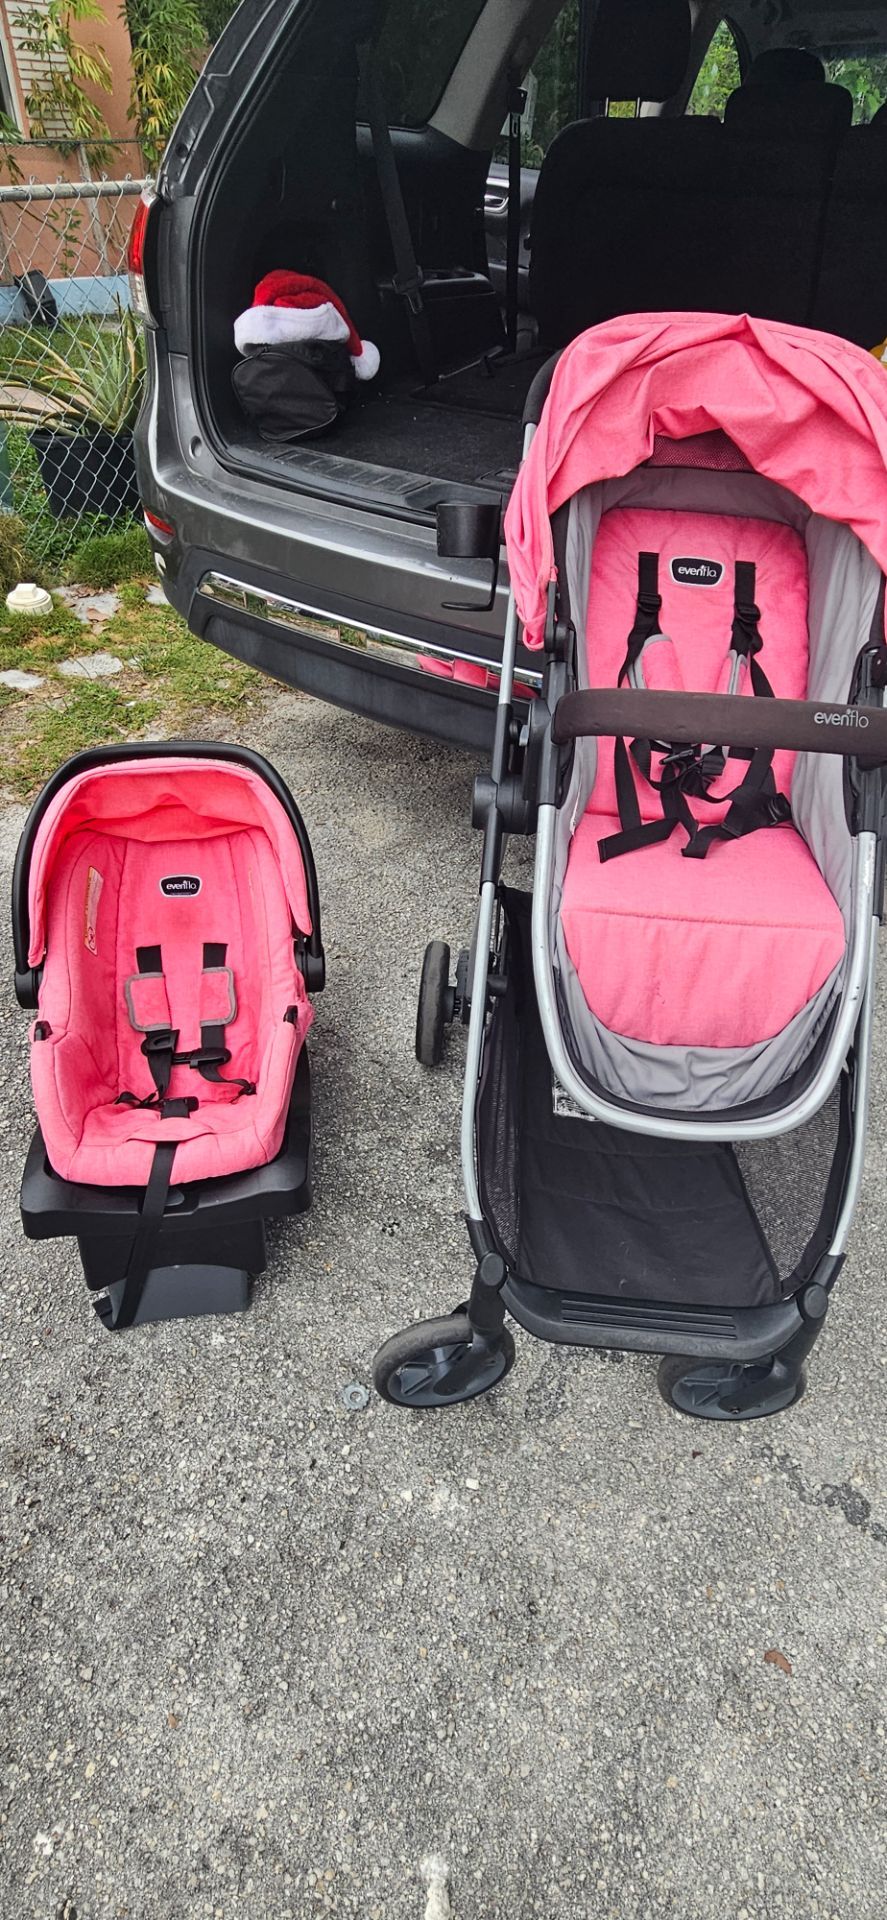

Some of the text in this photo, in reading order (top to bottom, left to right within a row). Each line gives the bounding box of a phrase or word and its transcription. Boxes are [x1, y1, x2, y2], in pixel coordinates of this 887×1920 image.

[678, 565, 717, 577] evenflo
[814, 708, 869, 728] evenflo
[166, 880, 197, 890] evenflo
